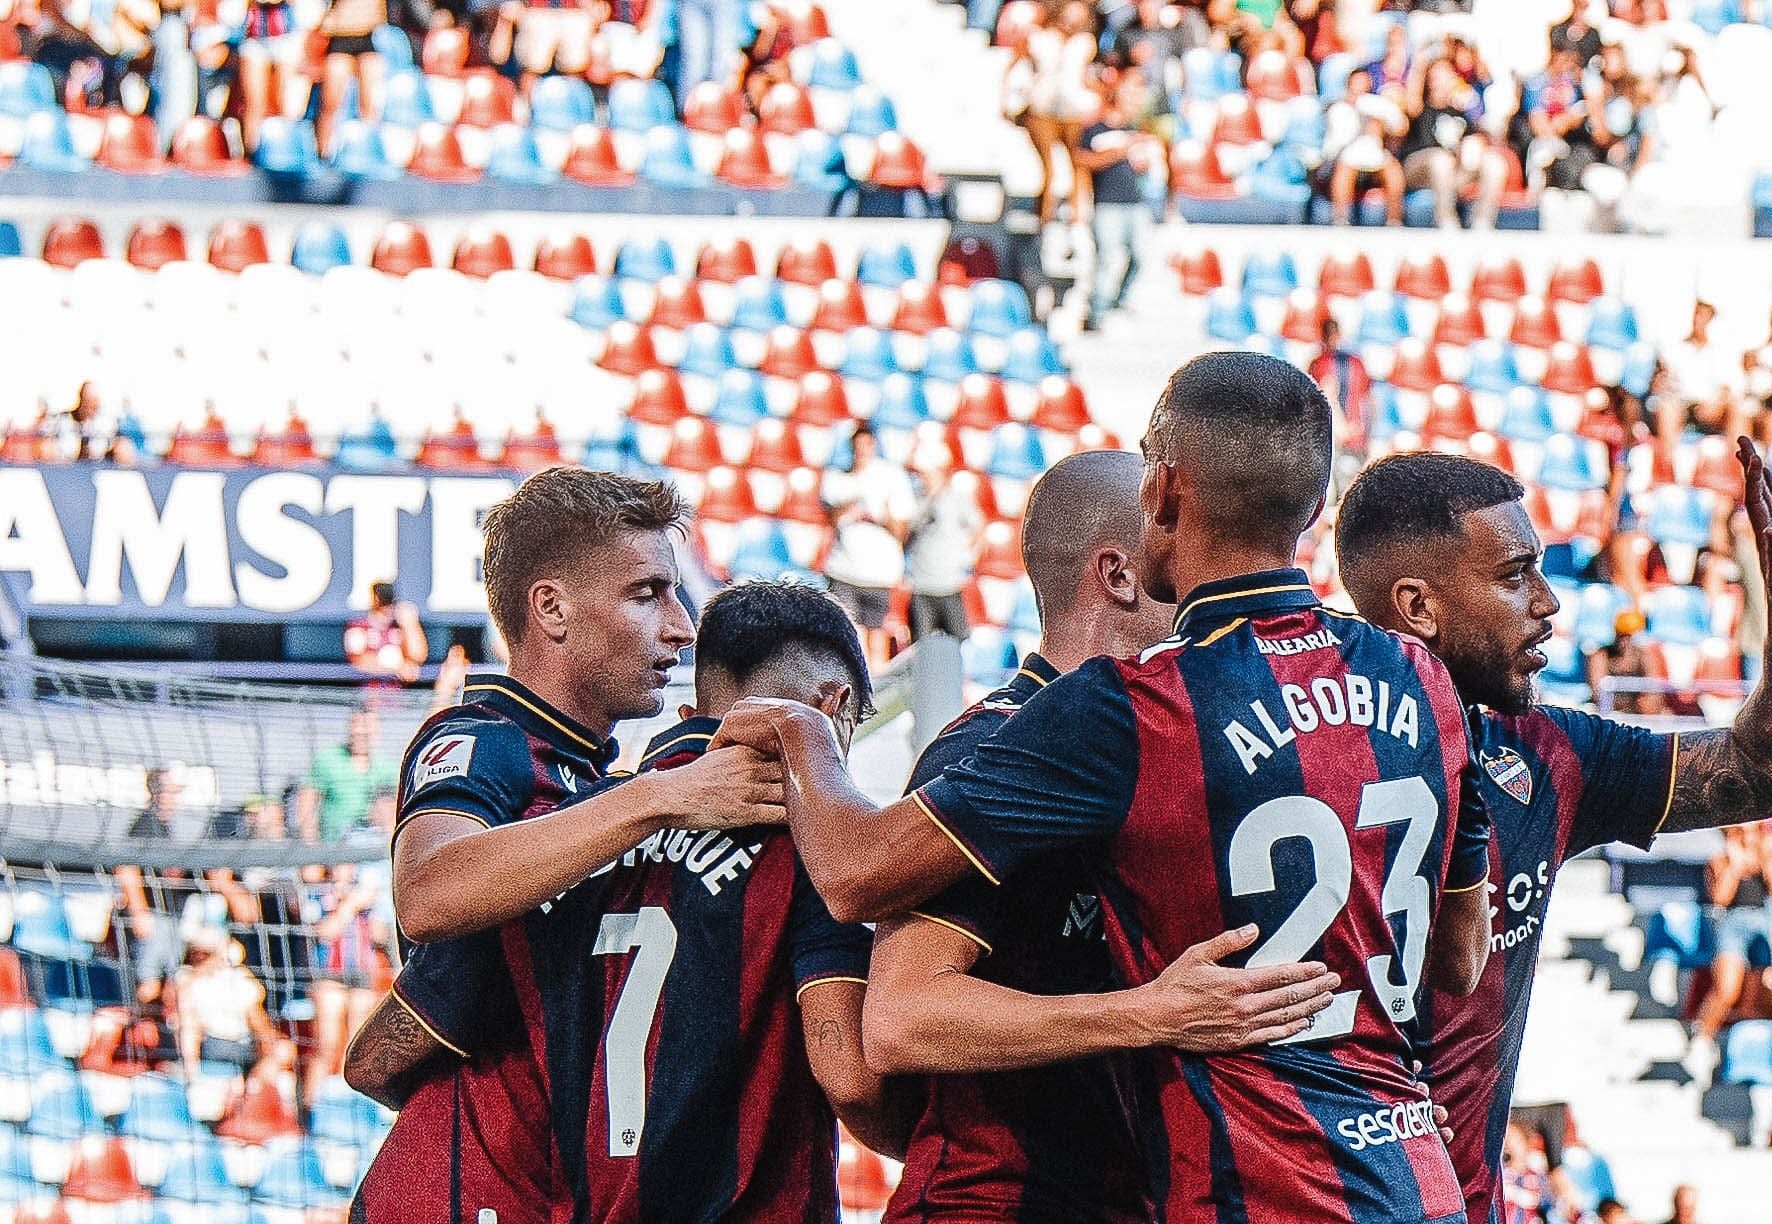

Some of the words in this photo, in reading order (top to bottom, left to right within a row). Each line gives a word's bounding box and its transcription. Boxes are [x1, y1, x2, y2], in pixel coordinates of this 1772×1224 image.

[1223, 673, 1419, 775] ALGOBIA
[592, 907, 678, 1157] 7
[1229, 776, 1439, 1046] 23
